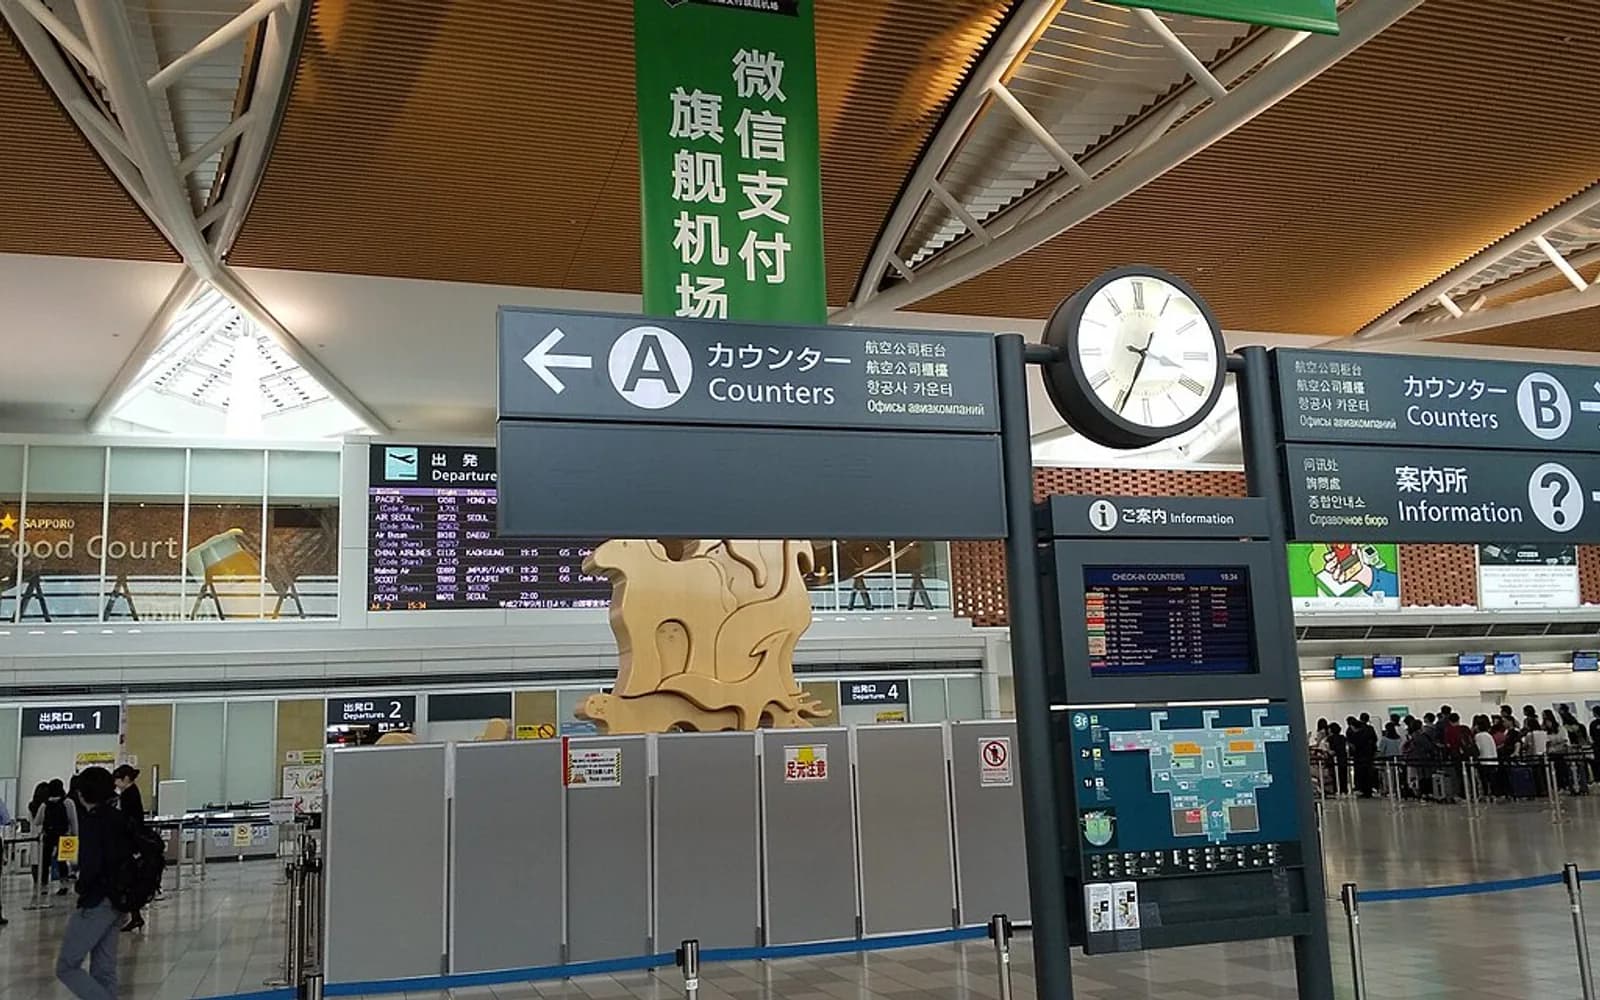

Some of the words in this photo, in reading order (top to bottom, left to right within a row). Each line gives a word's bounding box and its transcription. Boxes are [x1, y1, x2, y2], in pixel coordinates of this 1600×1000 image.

[732, 48, 792, 284] 微信支付
[669, 86, 729, 319] 旗舰机场
[707, 340, 852, 370] カウンター
[865, 340, 946, 357] 航空公司柜台
[621, 333, 682, 395] A
[709, 378, 835, 406] Counters
[867, 380, 908, 395] 항공사
[913, 381, 953, 397] 카운터
[1404, 375, 1507, 399] カウンター
[867, 400, 906, 414] Офисы
[907, 402, 985, 416] авиакомпаний
[1298, 396, 1332, 411] 항공사
[1336, 398, 1370, 412] 카운터
[1531, 380, 1560, 430] B
[1407, 405, 1499, 429] Counters
[1395, 466, 1468, 494] 案内所
[1308, 495, 1366, 509] 종합안내소
[466, 514, 489, 522] SEOUL
[1121, 508, 1167, 524] ご案内
[1170, 512, 1234, 525] Information
[1364, 513, 1389, 528] бюро
[1398, 501, 1523, 524] Information
[24, 518, 75, 529] SAPPORO
[86, 535, 179, 560] Court
[374, 549, 396, 557] CHINA
[399, 549, 432, 557] AIRLINES
[1147, 573, 1186, 581] COUNTERS
[374, 594, 398, 602] PEACH
[887, 683, 899, 700] 4
[343, 711, 385, 720] Departures
[389, 701, 402, 719] 2
[38, 721, 85, 731] Departures
[39, 711, 73, 722] 出発口
[91, 711, 102, 729] 1
[786, 760, 827, 779] 足元注意
